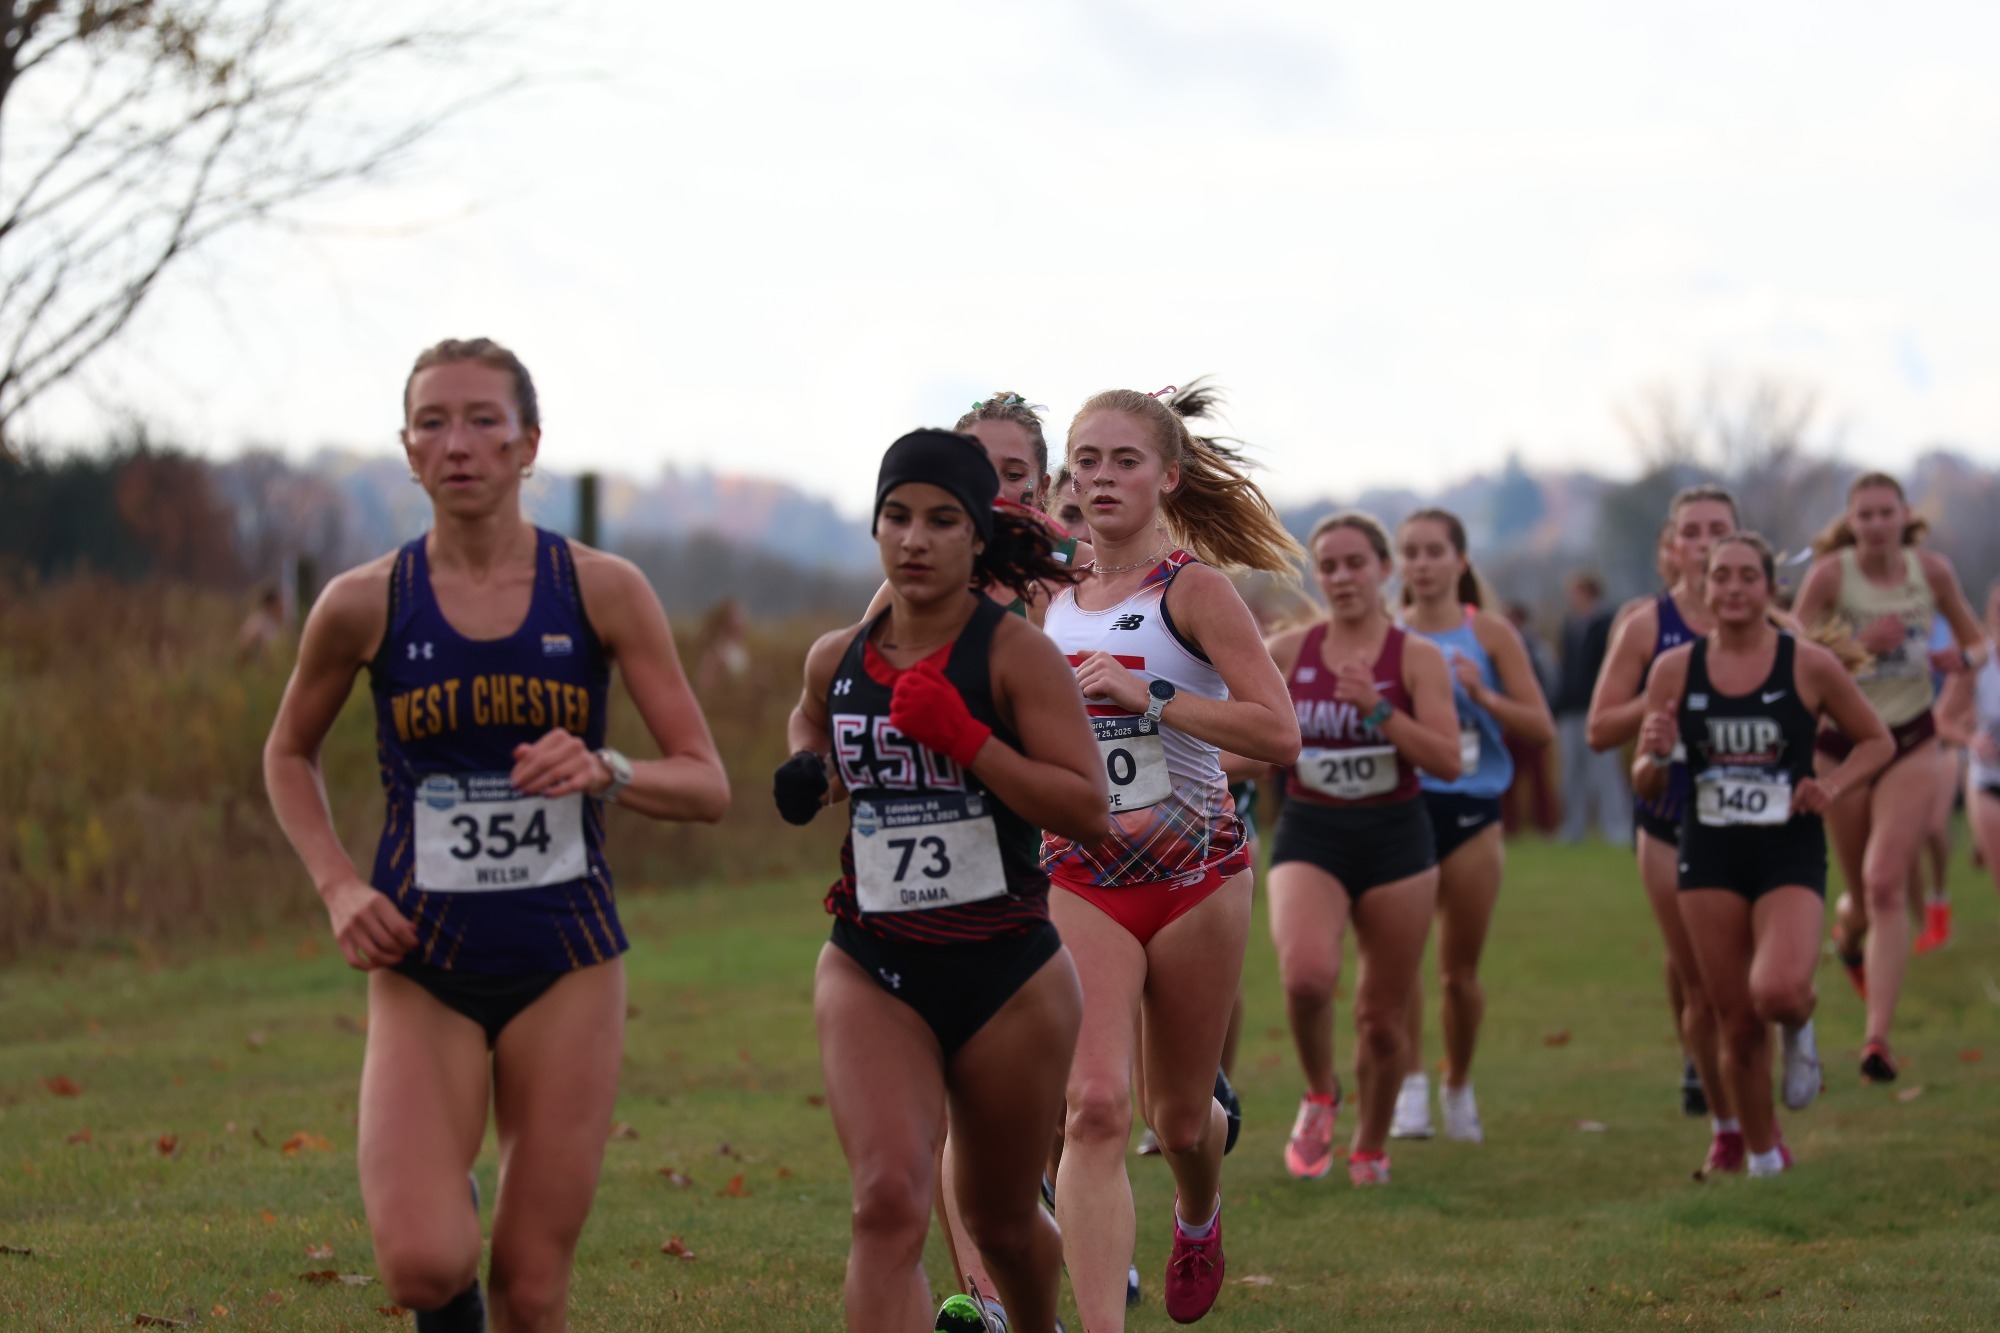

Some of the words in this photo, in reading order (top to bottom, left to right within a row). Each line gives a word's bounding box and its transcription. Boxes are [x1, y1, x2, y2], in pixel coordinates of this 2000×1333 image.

[390, 677, 461, 741] WEST
[472, 673, 590, 734] CHESTER
[1101, 730, 1113, 738] 25,
[1113, 727, 1132, 737] 2025
[1106, 720, 1117, 728] PA
[1704, 717, 1782, 755] IUP
[1106, 747, 1137, 786] 0
[1318, 756, 1375, 784] 210
[1715, 785, 1767, 814] 140
[450, 807, 552, 861] 354
[476, 866, 530, 885] WELSH
[887, 836, 951, 883] 73
